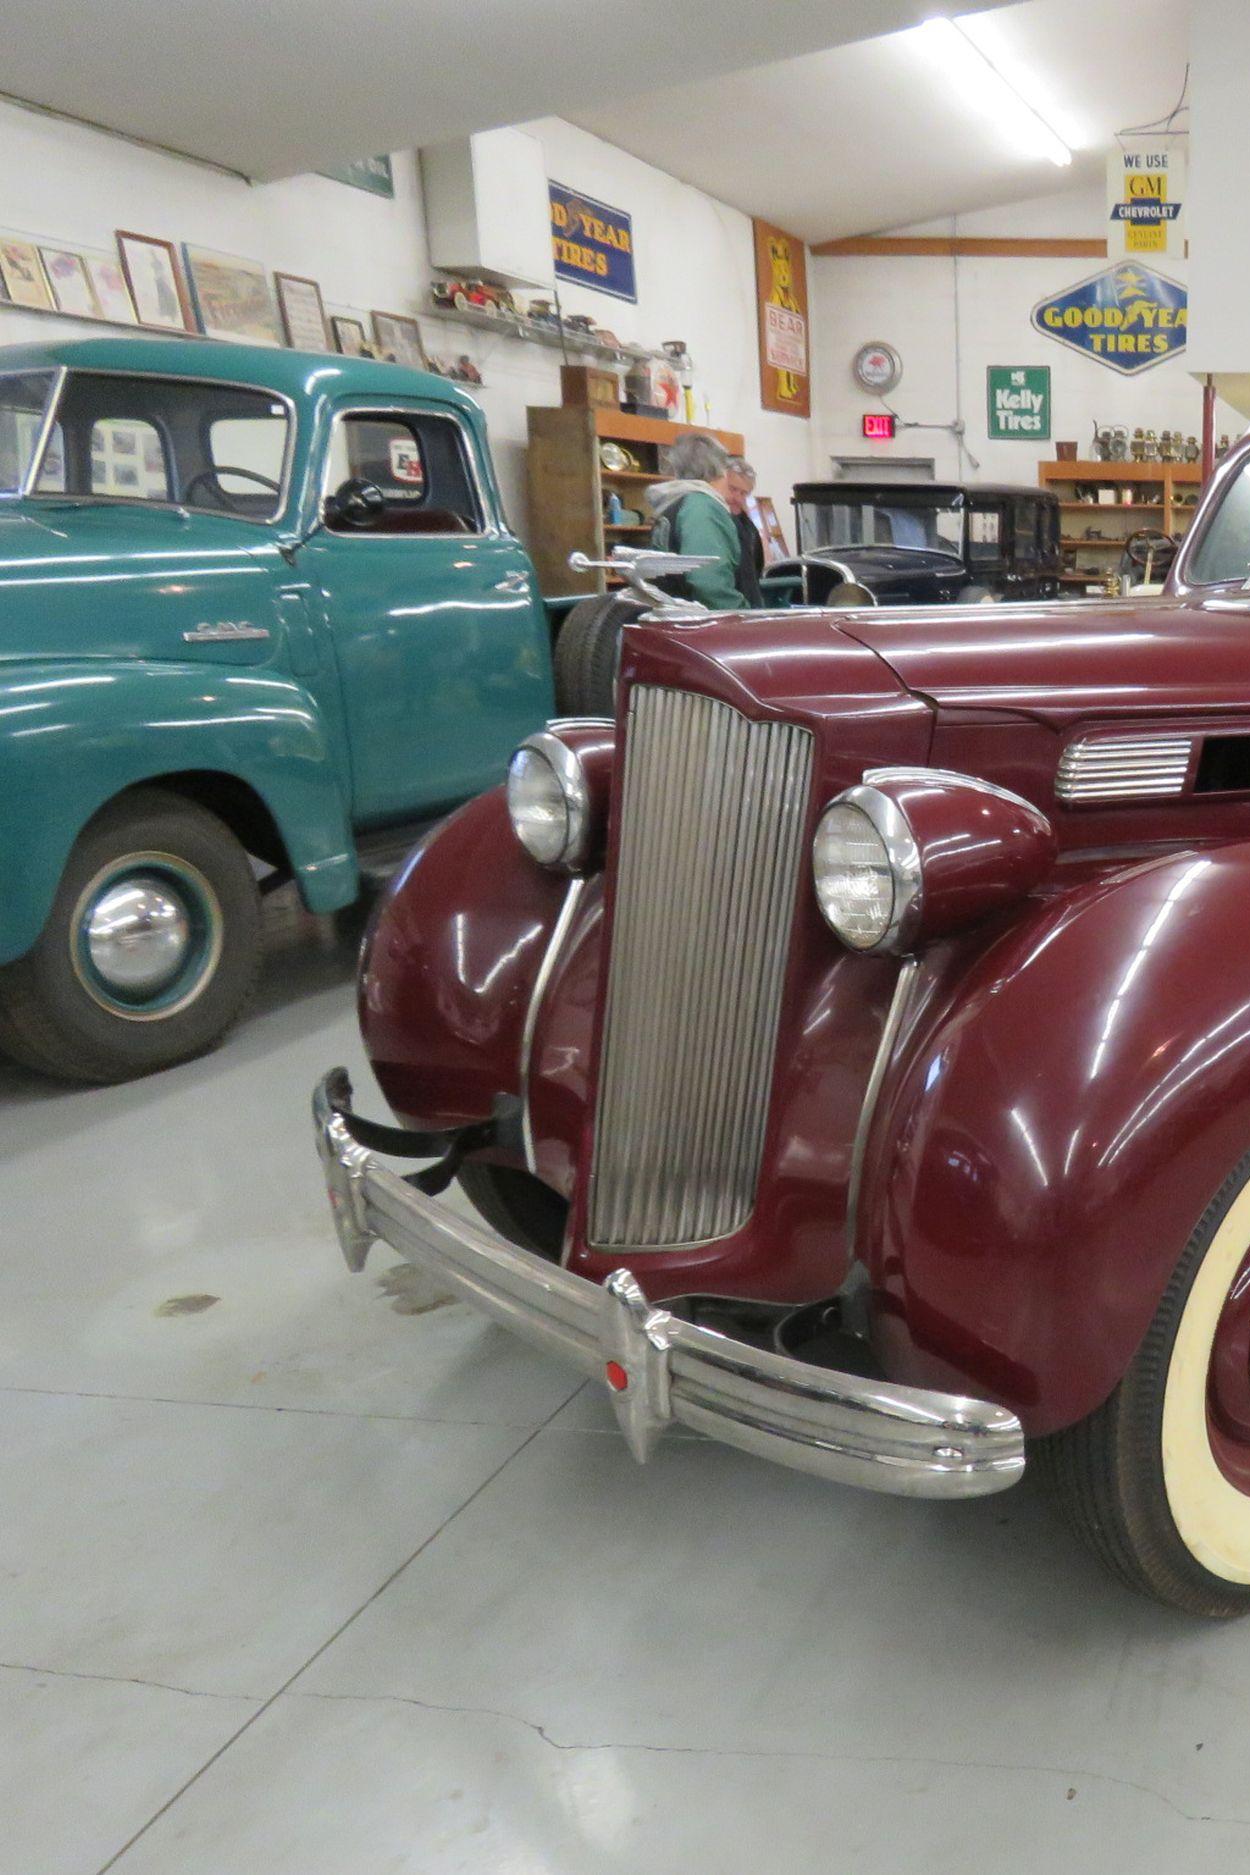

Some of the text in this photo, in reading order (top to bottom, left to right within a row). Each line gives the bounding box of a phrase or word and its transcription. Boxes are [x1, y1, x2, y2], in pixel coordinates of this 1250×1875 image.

[1124, 154, 1168, 168] WE USE
[1129, 176, 1161, 196] GM
[1118, 206, 1174, 218] CHEVROLET
[552, 236, 608, 275] TIRES
[1089, 333, 1169, 353] TIRES
[996, 389, 1043, 413] Kelly
[865, 416, 890, 435] EXIT
[996, 410, 1041, 431] Tires
